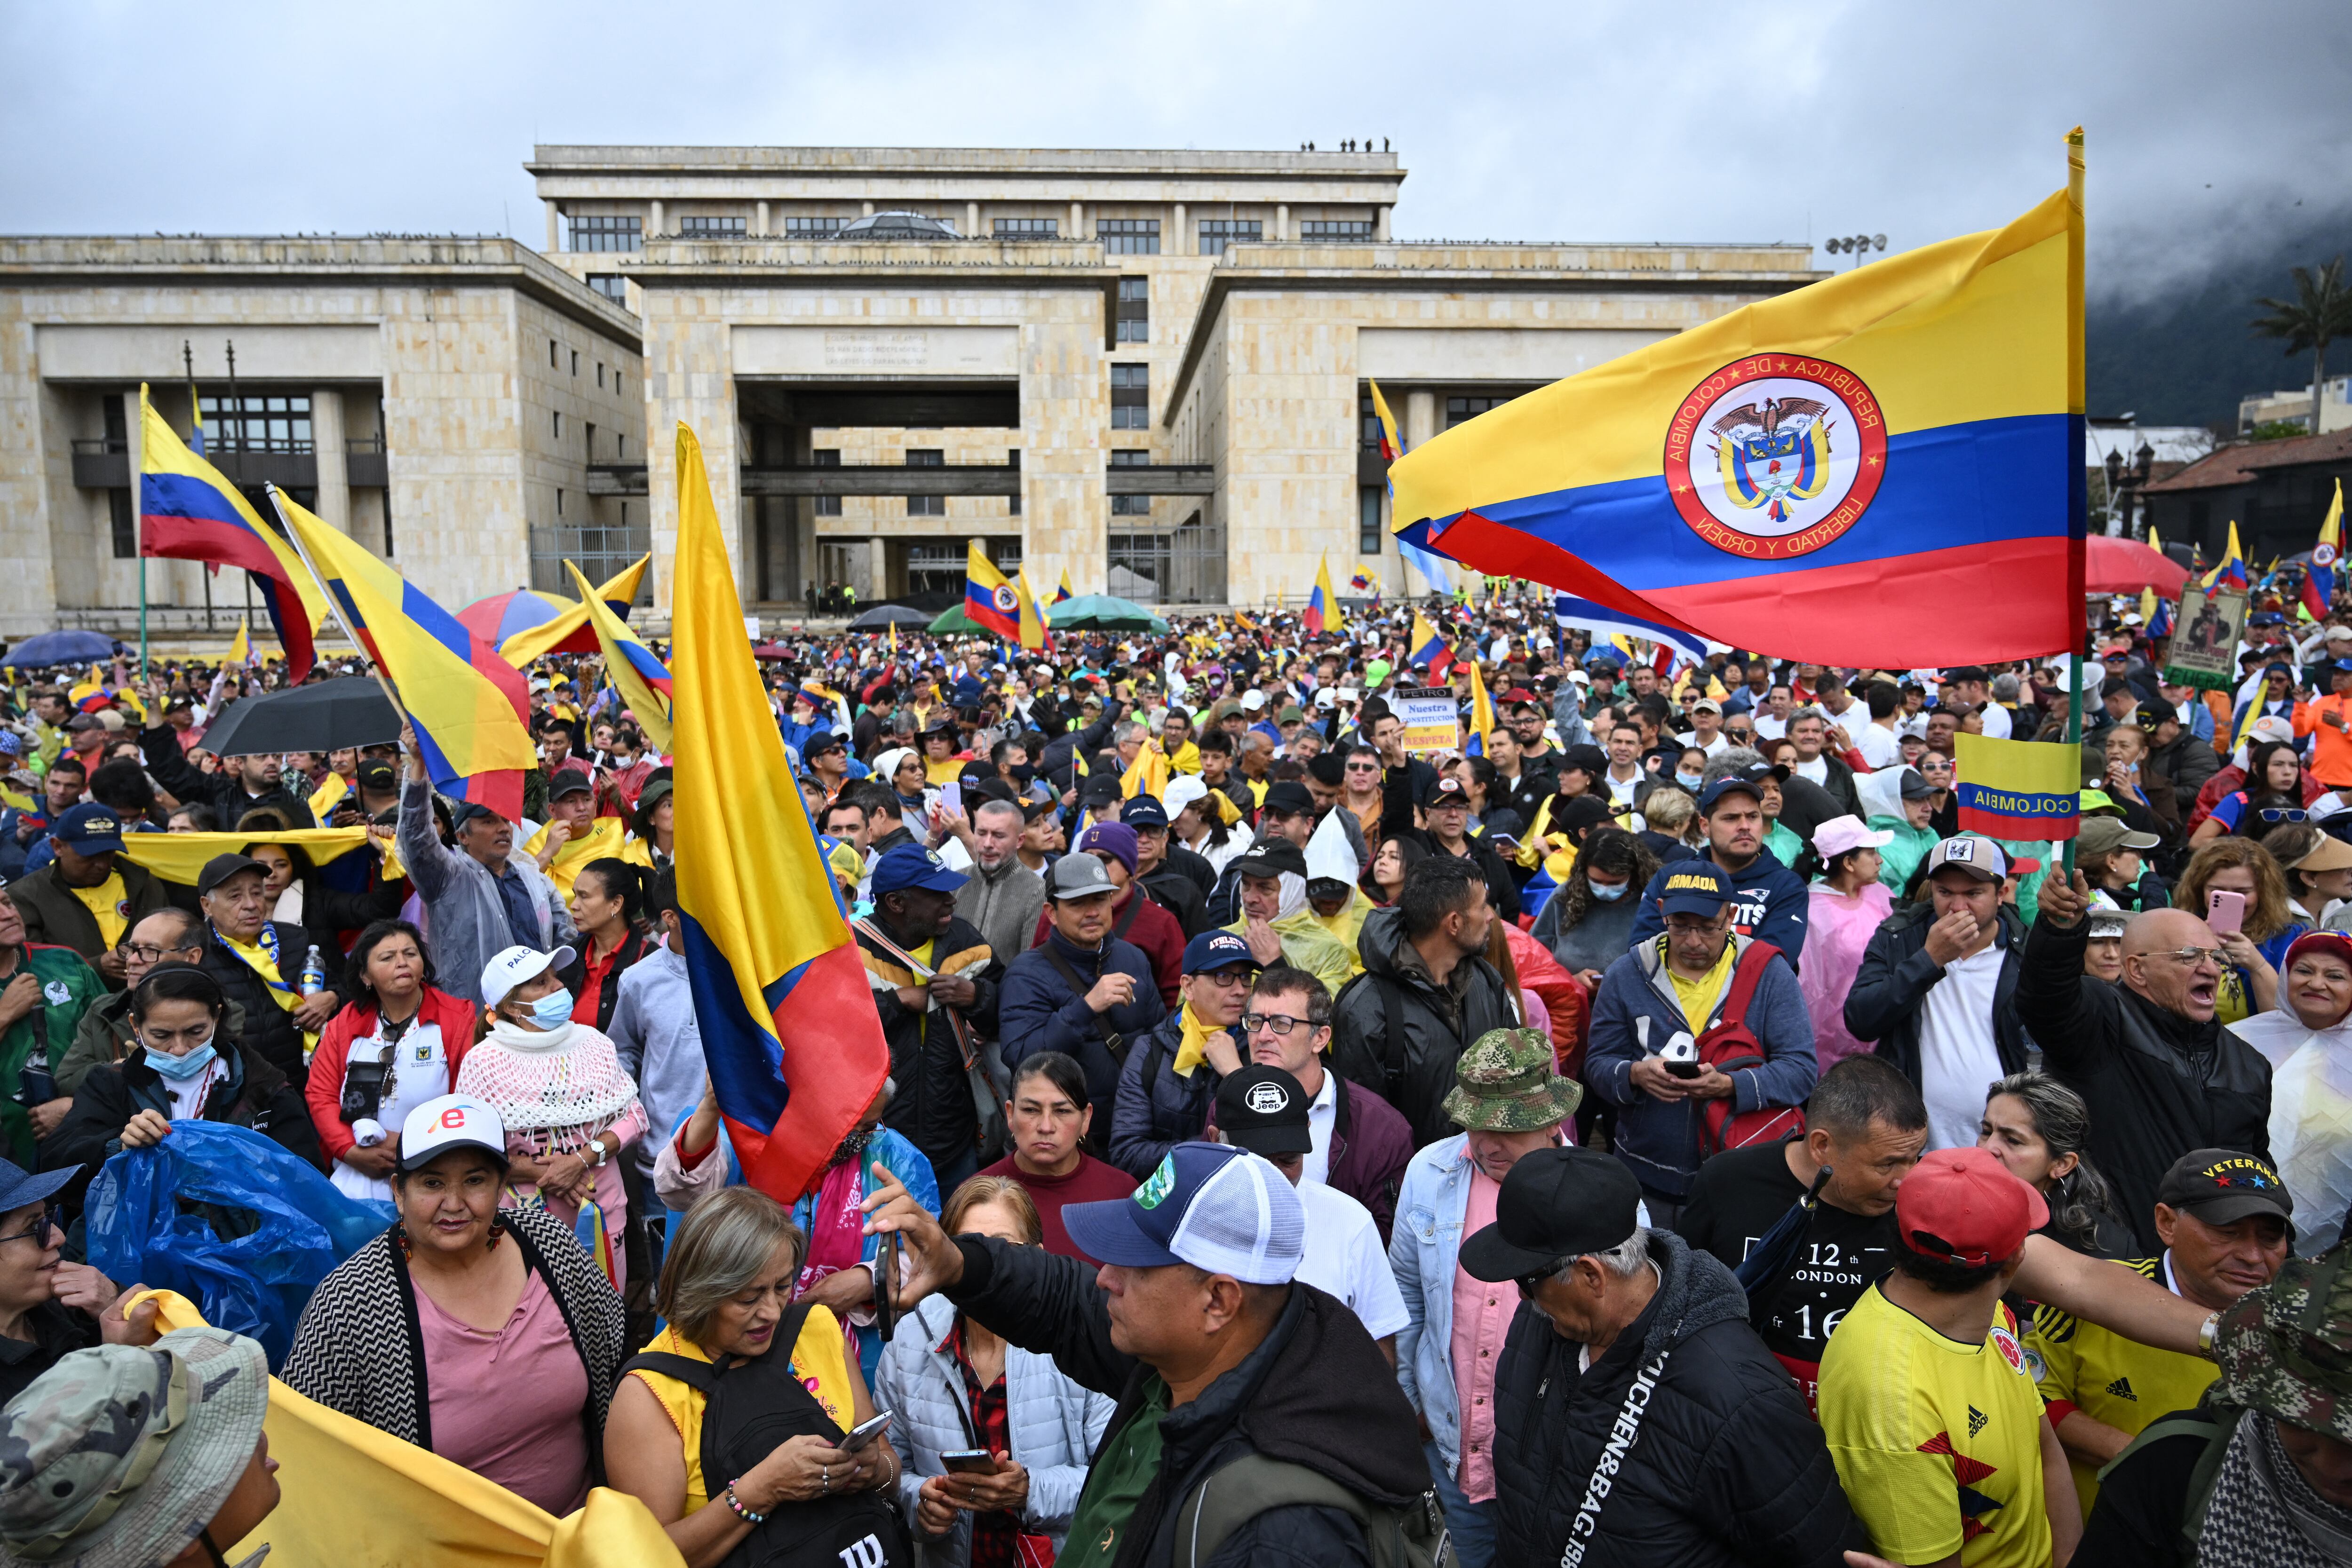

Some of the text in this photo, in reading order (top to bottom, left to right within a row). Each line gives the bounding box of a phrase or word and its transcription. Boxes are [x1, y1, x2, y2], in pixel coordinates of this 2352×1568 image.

[2167, 668, 2228, 692] FUERA
[1402, 689, 1446, 697] PETRO
[1402, 715, 1455, 723] CONSTITUCION
[1405, 735, 1452, 745] RESPETA
[1665, 874, 1718, 892] ARMADA
[2202, 1159, 2279, 1185] VETERANO
[1808, 1243, 1840, 1266] 12
[1791, 1270, 1861, 1285] ONDON
[2105, 1386, 2137, 1402] adidas
[1969, 1413, 1988, 1439] adidas
